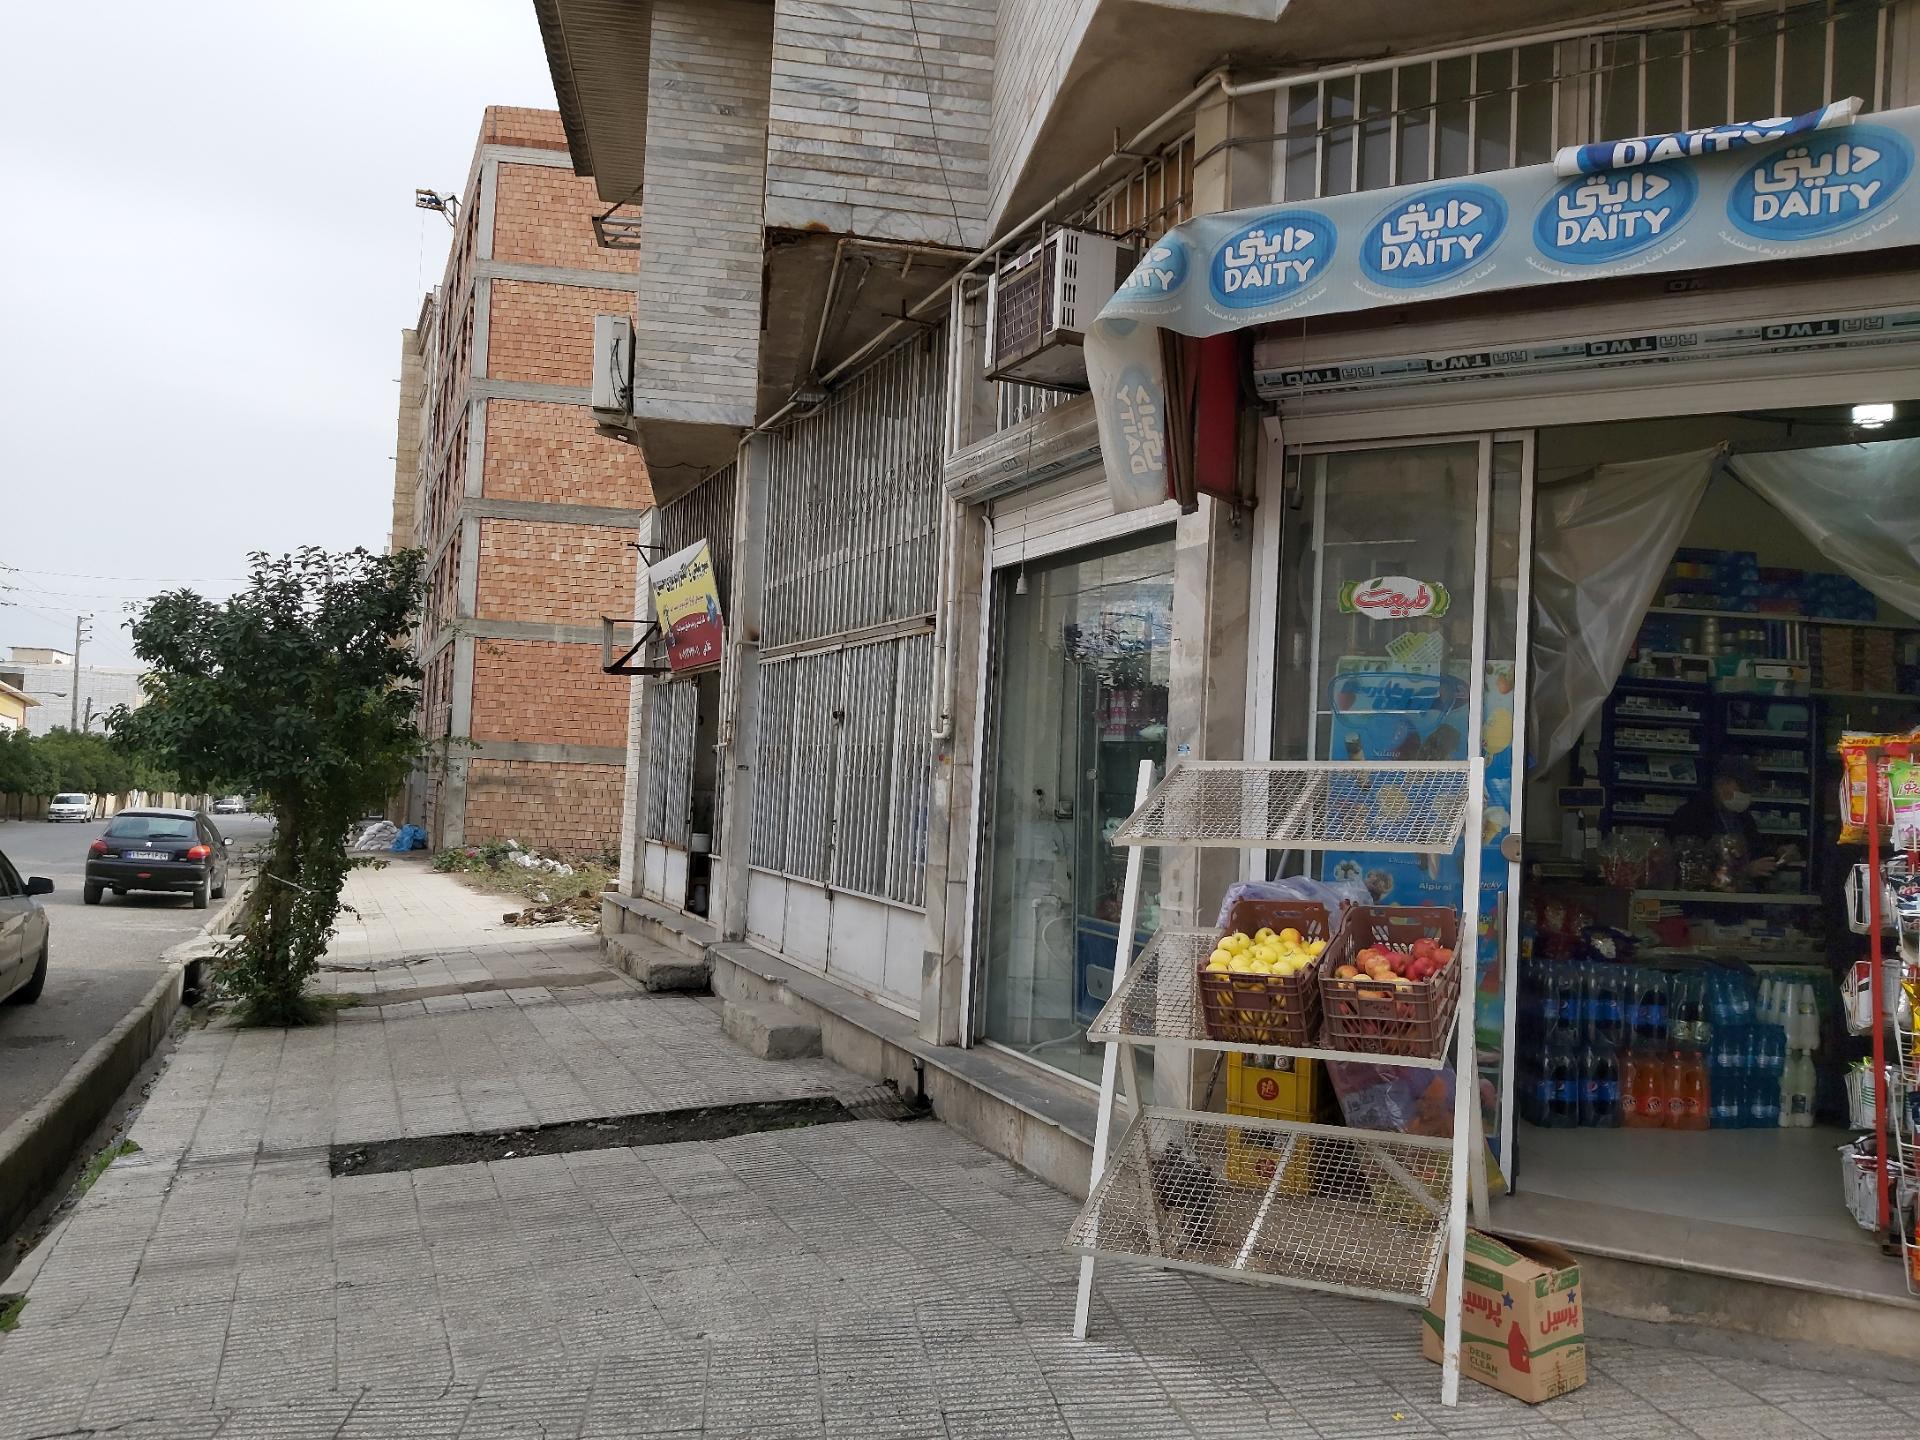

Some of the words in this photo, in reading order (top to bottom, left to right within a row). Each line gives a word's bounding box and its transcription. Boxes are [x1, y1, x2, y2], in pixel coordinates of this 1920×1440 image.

[1754, 144, 1881, 194] دایتی
[1558, 172, 1671, 220] دایتی
[1753, 180, 1881, 222] DAITY
[1382, 199, 1483, 245] دایتی
[1556, 207, 1671, 247] DAITY
[1224, 227, 1314, 269] دایتی
[1381, 233, 1483, 272] DAITY
[1224, 258, 1315, 294] DAITY
[1354, 583, 1430, 616] طبیعت
[1463, 1291, 1502, 1328] پرسی
[1540, 1304, 1578, 1335] پرسیل
[1469, 1356, 1498, 1374] CLEAN
